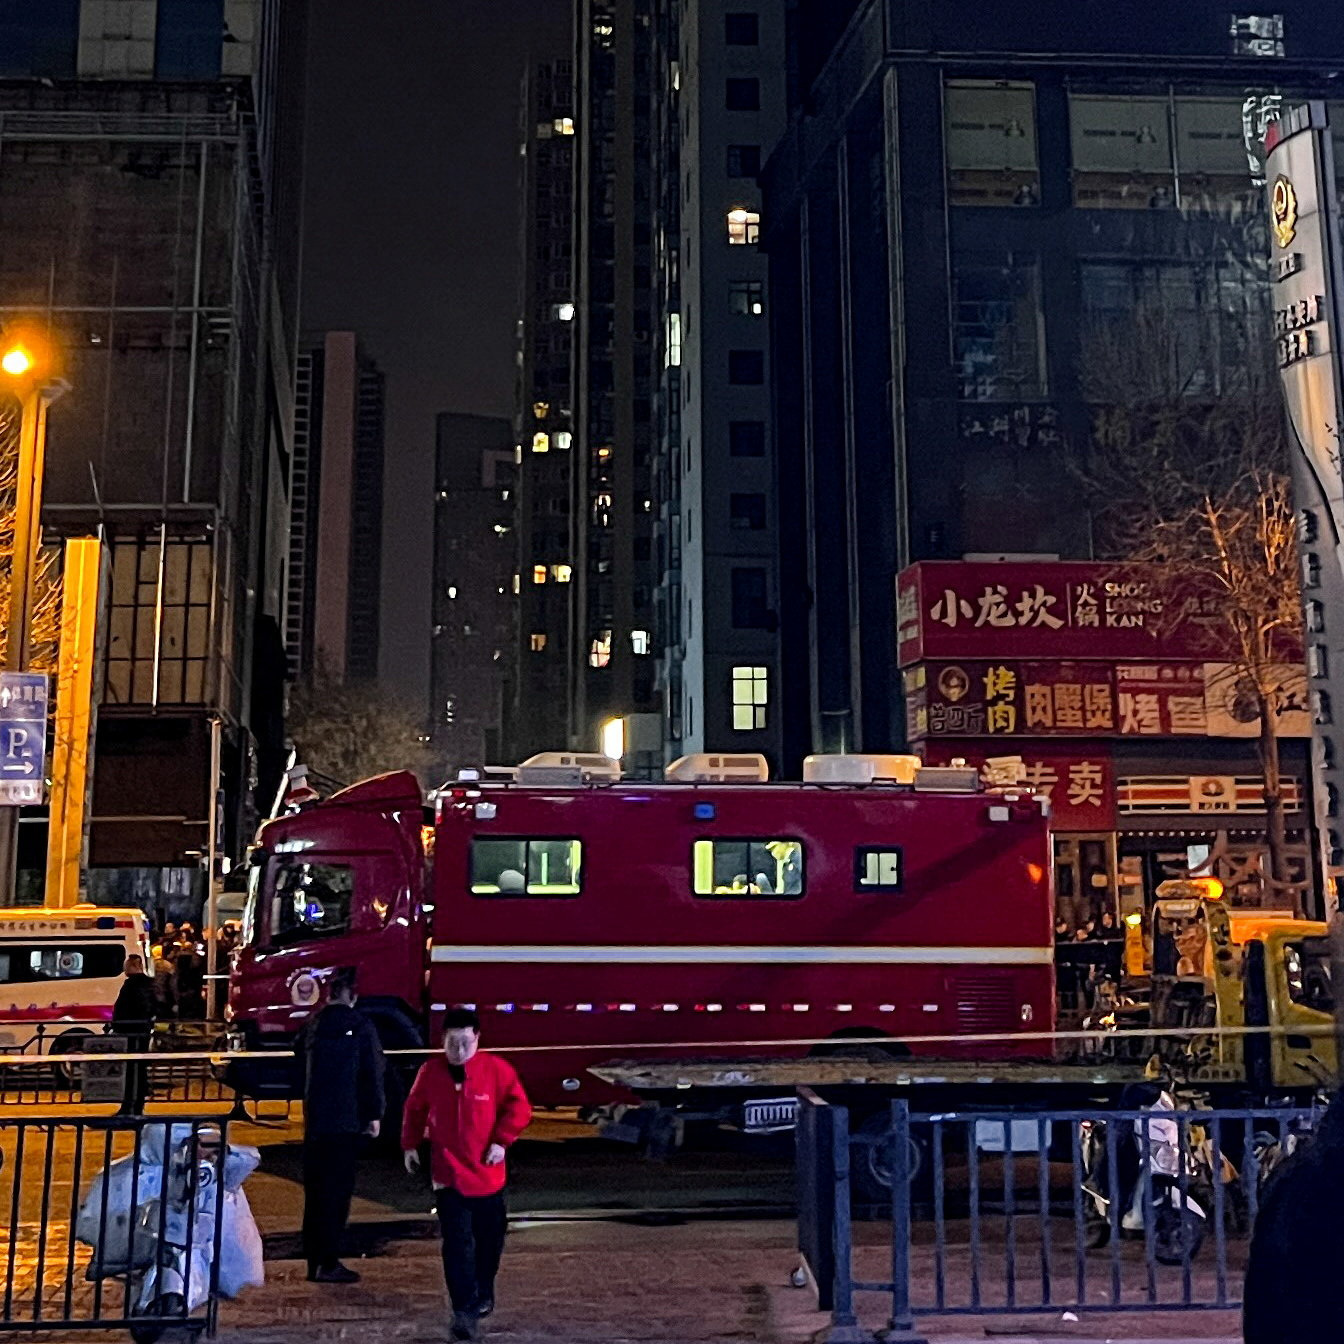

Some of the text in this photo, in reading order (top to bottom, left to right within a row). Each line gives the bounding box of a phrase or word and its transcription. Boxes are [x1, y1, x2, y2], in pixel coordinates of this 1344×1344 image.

[930, 584, 1065, 630] 小龙坎
[1074, 581, 1099, 628] 火锅
[1106, 613, 1144, 628] KAN
[981, 664, 1017, 735] 烤肉
[1024, 683, 1114, 729] 肉蟹煲
[6, 727, 29, 759] P
